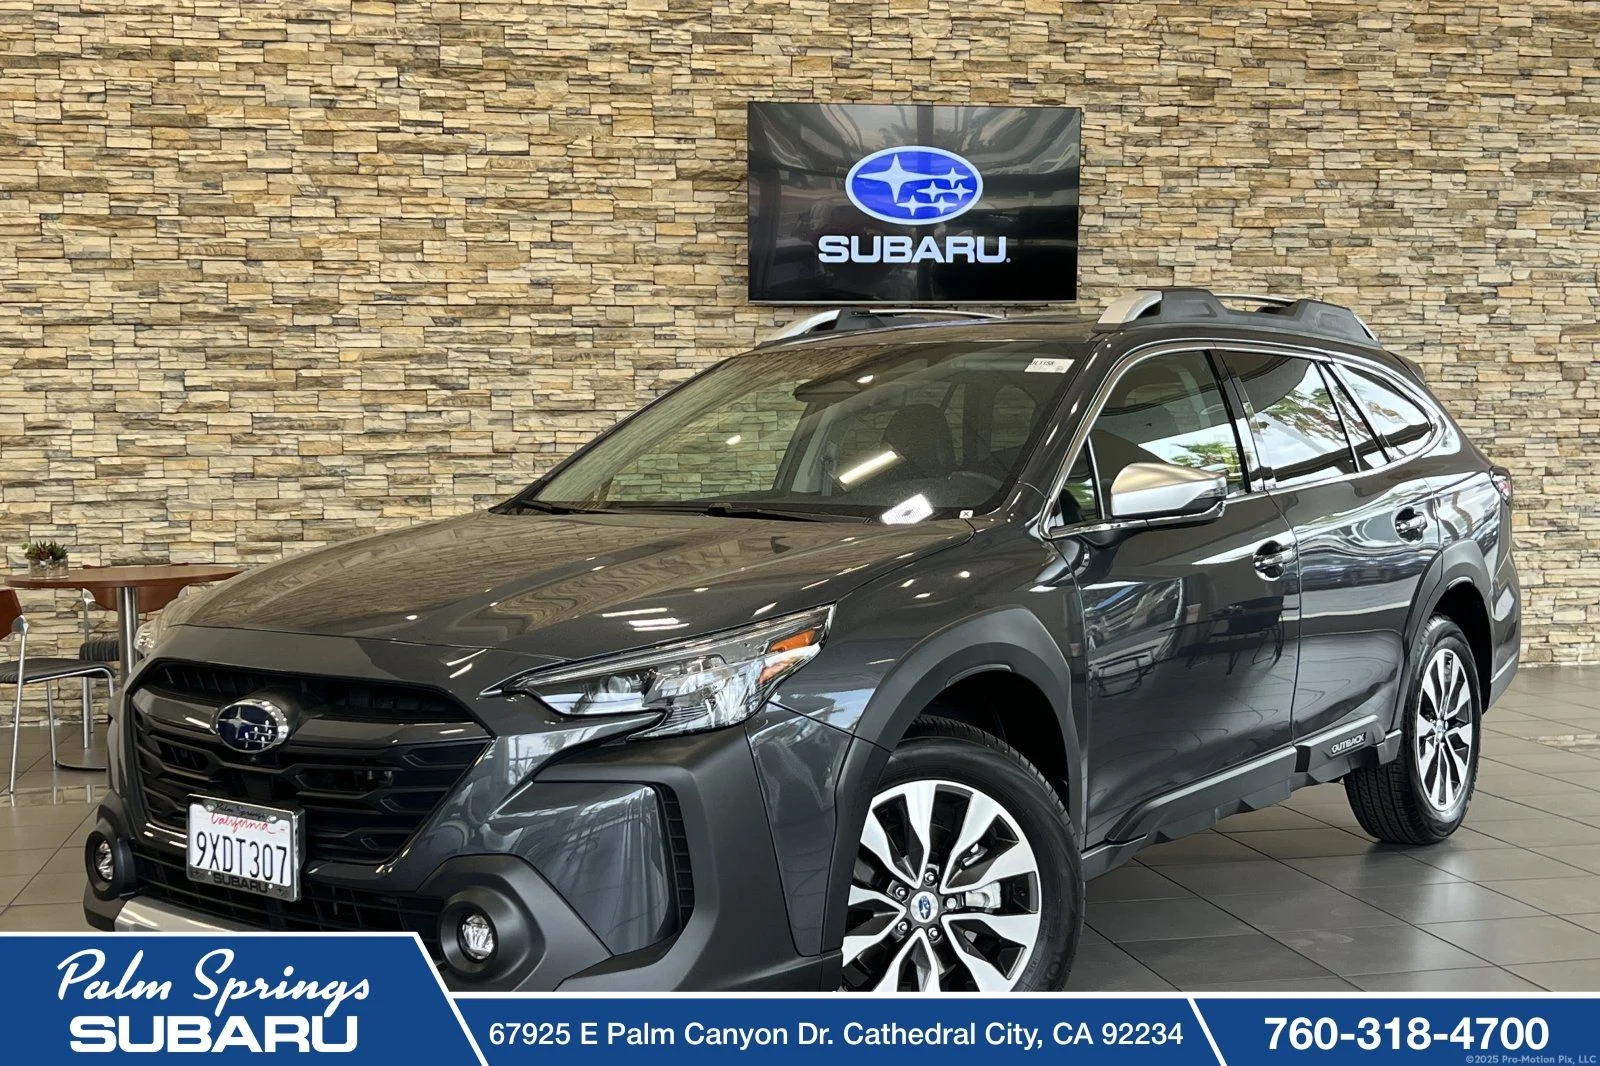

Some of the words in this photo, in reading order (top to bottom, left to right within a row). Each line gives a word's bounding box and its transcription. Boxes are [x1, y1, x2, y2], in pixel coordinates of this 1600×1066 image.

[818, 235, 1007, 264] SUBARU
[1331, 733, 1364, 753] OUTBACK
[211, 812, 276, 834] California
[196, 831, 287, 883] 9XDT307
[213, 871, 268, 893] SUBARU
